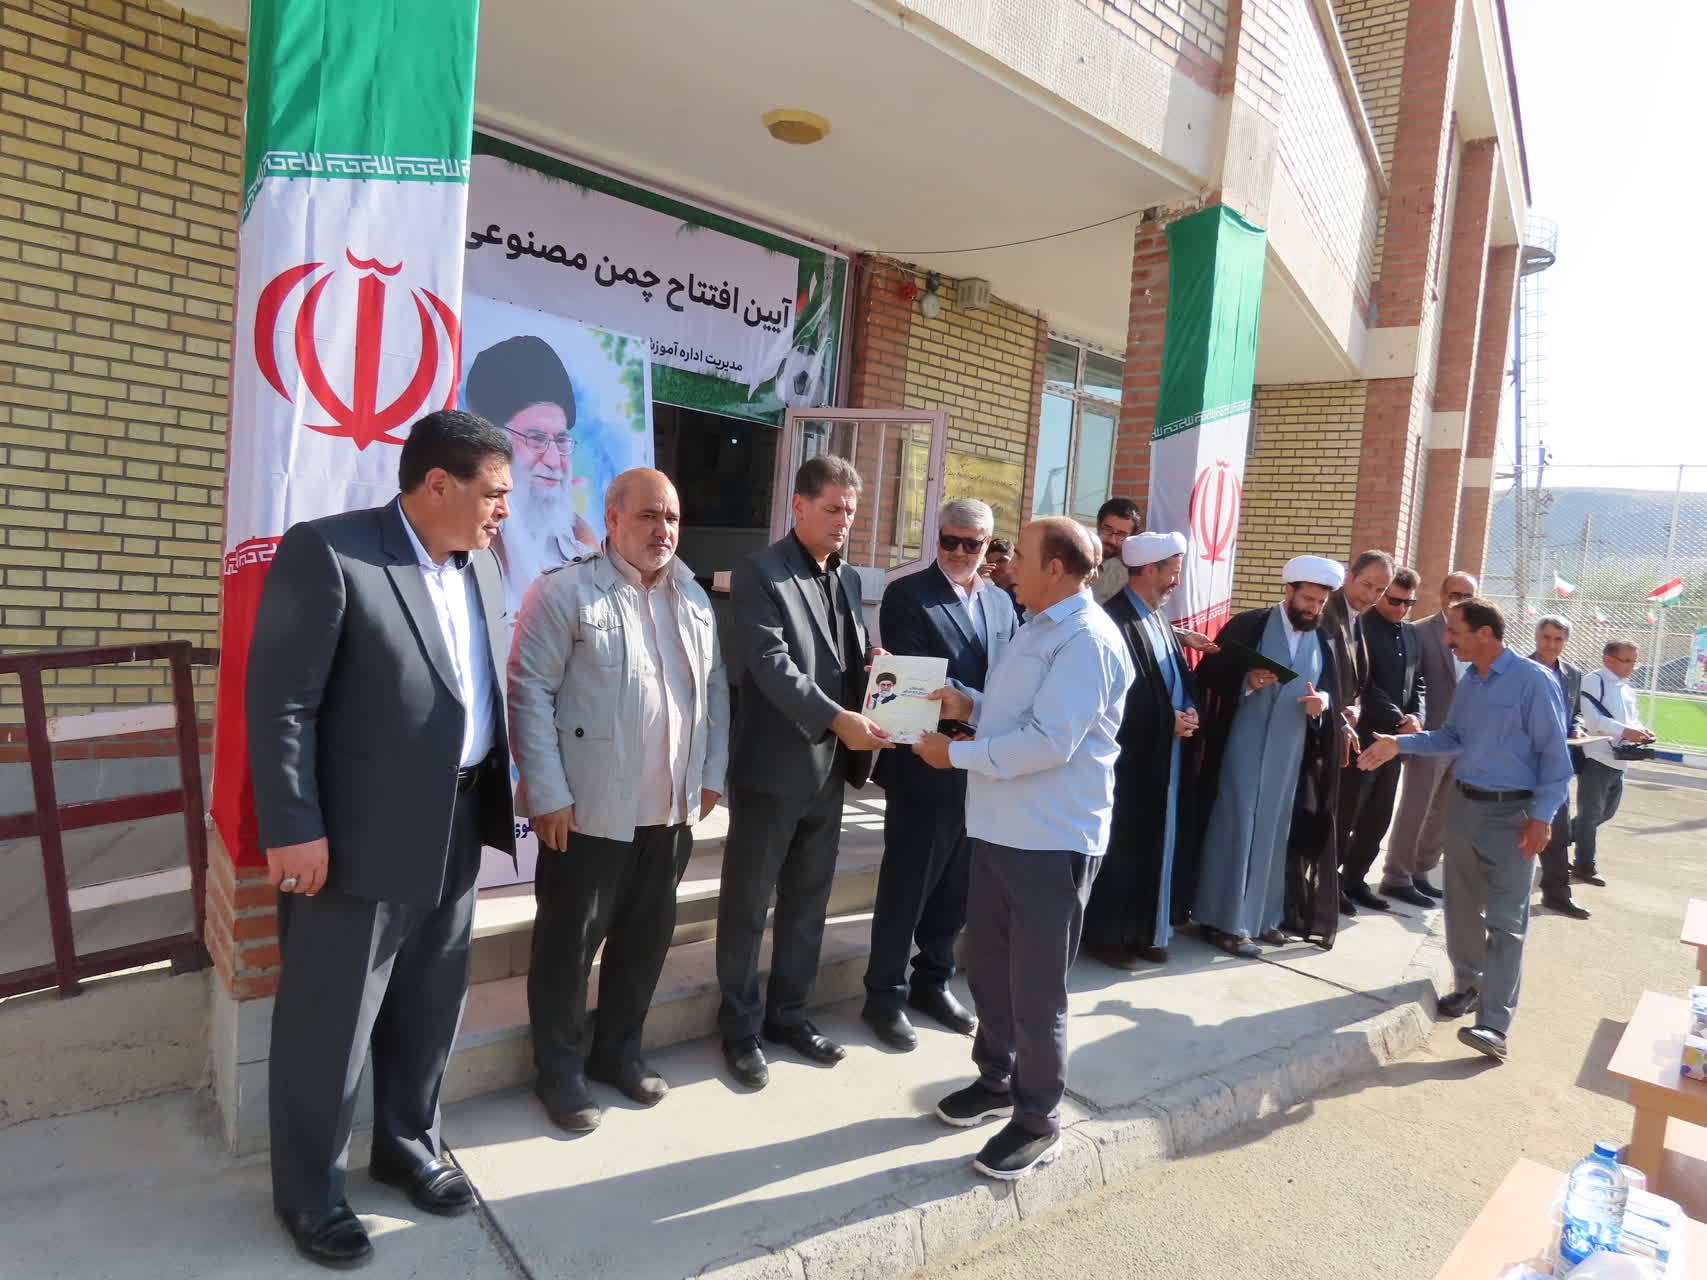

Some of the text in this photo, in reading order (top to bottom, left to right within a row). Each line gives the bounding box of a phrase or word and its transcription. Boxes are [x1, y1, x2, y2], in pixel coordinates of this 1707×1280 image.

[465, 223, 793, 334] آیین افتتاح چمن مصنوعی
[679, 347, 703, 362] اداره
[705, 354, 743, 373] مدیریت
